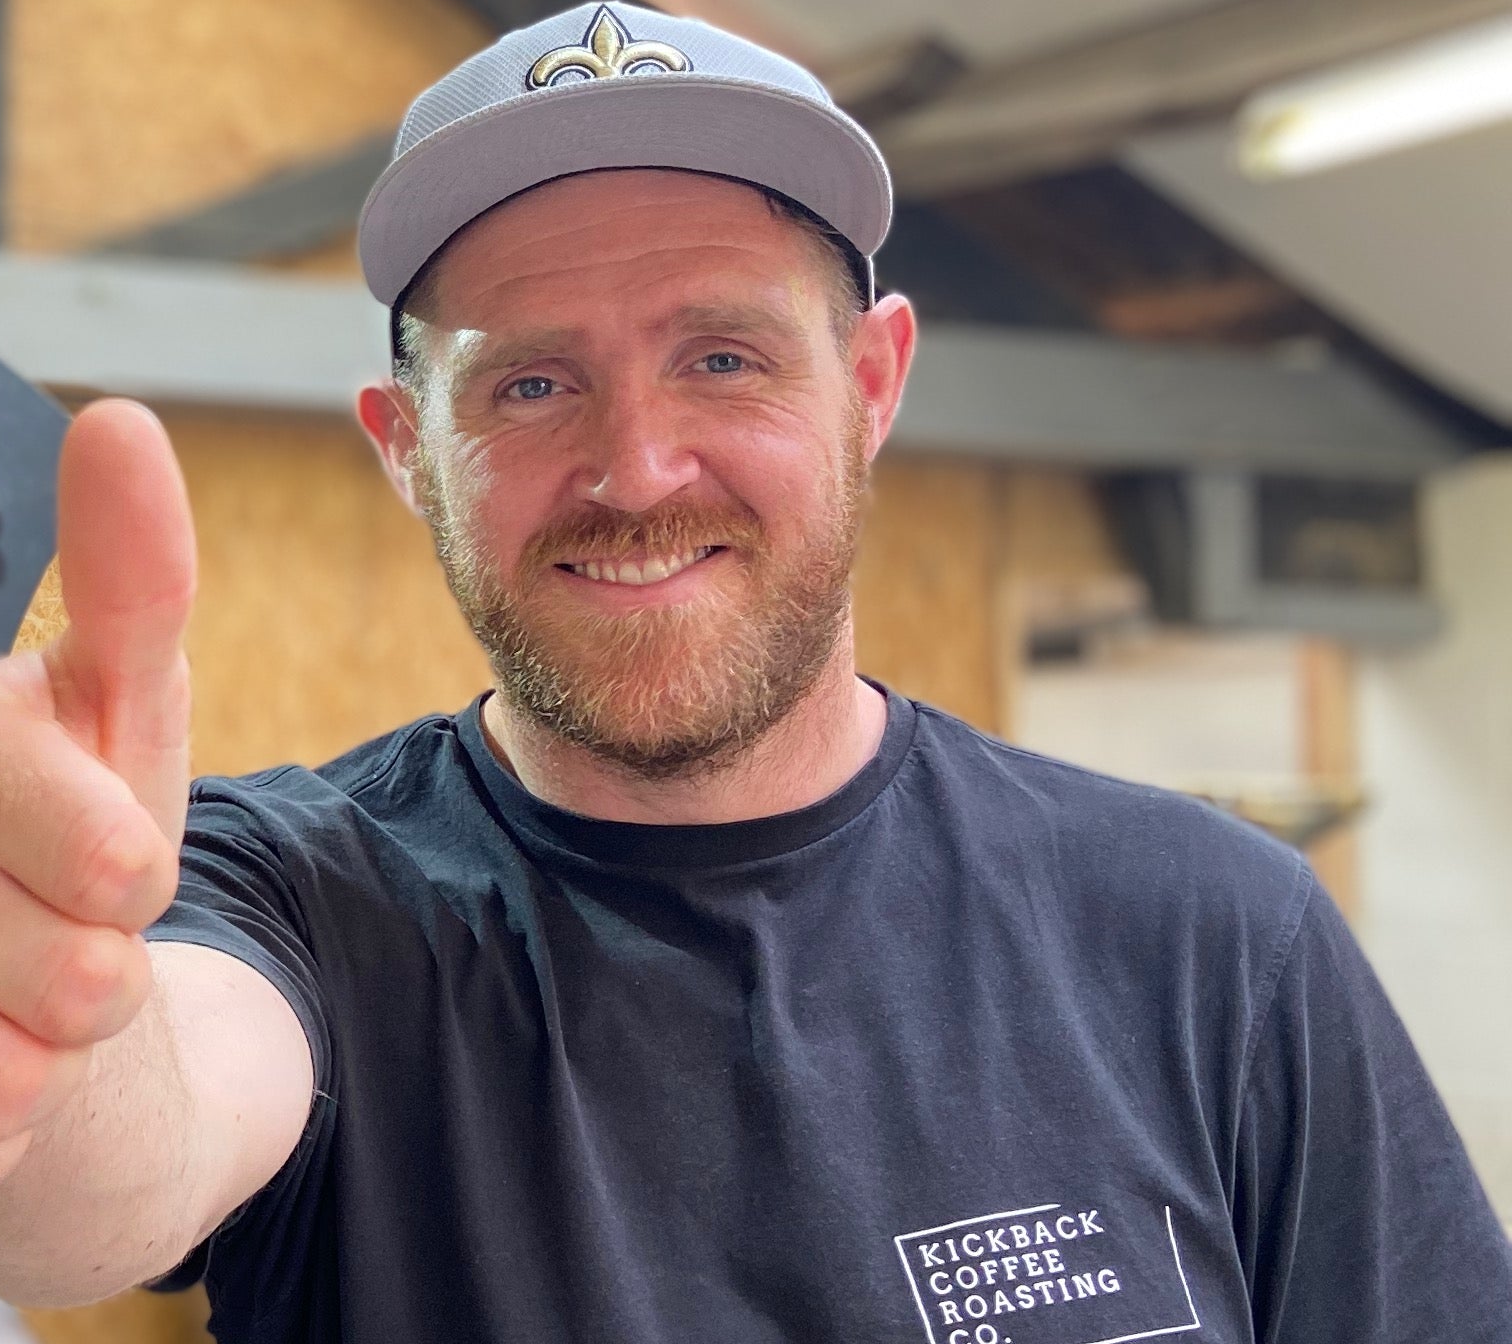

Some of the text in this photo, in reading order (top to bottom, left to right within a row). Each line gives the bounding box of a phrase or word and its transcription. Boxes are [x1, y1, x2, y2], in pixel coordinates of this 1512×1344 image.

[918, 1209, 1105, 1268] KICKBACK
[929, 1248, 1066, 1295] COFFEE
[938, 1268, 1121, 1325] ROASTING
